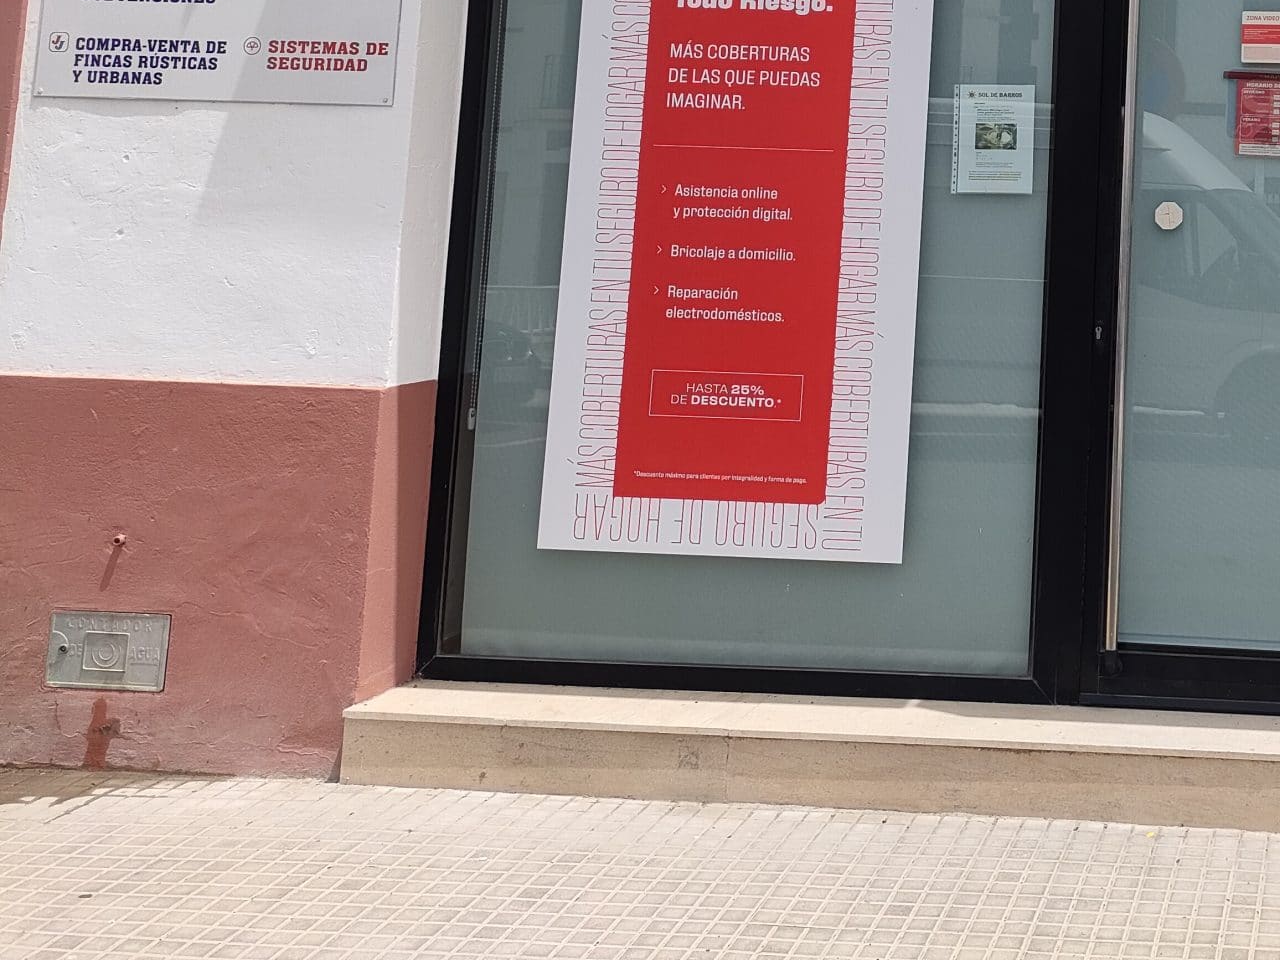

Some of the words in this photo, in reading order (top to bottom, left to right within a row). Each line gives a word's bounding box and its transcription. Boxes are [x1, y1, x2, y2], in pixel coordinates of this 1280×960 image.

[75, 37, 200, 54] COMPRA-VENTA
[205, 39, 228, 54] DE
[268, 39, 361, 55] SISTEMAS
[365, 41, 389, 56] DE
[601, 21, 650, 62] MÁS
[670, 38, 704, 60] MÁS
[707, 44, 810, 63] COBERTURAS
[73, 54, 132, 69] FINCAS
[137, 52, 218, 70] RÚSTICAS
[266, 56, 368, 72] SEGURIDAD
[72, 70, 84, 84] Y
[86, 70, 163, 86] URBANAS
[668, 68, 690, 84] DE
[692, 68, 721, 85] LAS
[725, 69, 757, 87] QUE
[759, 70, 820, 88] PUEDAS
[851, 66, 890, 90] EN
[604, 66, 648, 131] HOGAR
[666, 93, 746, 110] IMAGINAR.
[849, 94, 888, 118] TU
[601, 136, 642, 161] DE
[844, 124, 887, 201] SEGURO
[674, 183, 738, 200] Asistencia
[741, 186, 778, 201] online
[595, 167, 639, 245] SEGURO
[673, 207, 681, 221] y
[683, 204, 750, 221] protección
[752, 205, 793, 223] digital.
[842, 207, 882, 232] DE
[593, 250, 633, 273] TU
[670, 244, 726, 262] Bricolaje
[728, 250, 736, 260] a
[738, 246, 796, 262] domicilio.
[837, 237, 880, 304] HOGAR
[591, 280, 631, 303] EN
[667, 284, 738, 304] Reparación
[665, 306, 786, 324] electrodomésticos.
[835, 309, 884, 352] MÁS
[578, 309, 629, 439] COBERTURAS
[670, 394, 688, 405] DE
[686, 383, 729, 394] HASTA
[731, 384, 765, 396] 25%
[826, 356, 873, 489] COBERTURAS
[567, 445, 617, 488] MÁS
[573, 493, 662, 543] HOGAR
[823, 494, 865, 520] EN
[671, 499, 704, 544] DE
[715, 499, 819, 550] SEGURO
[821, 526, 863, 552] TU
